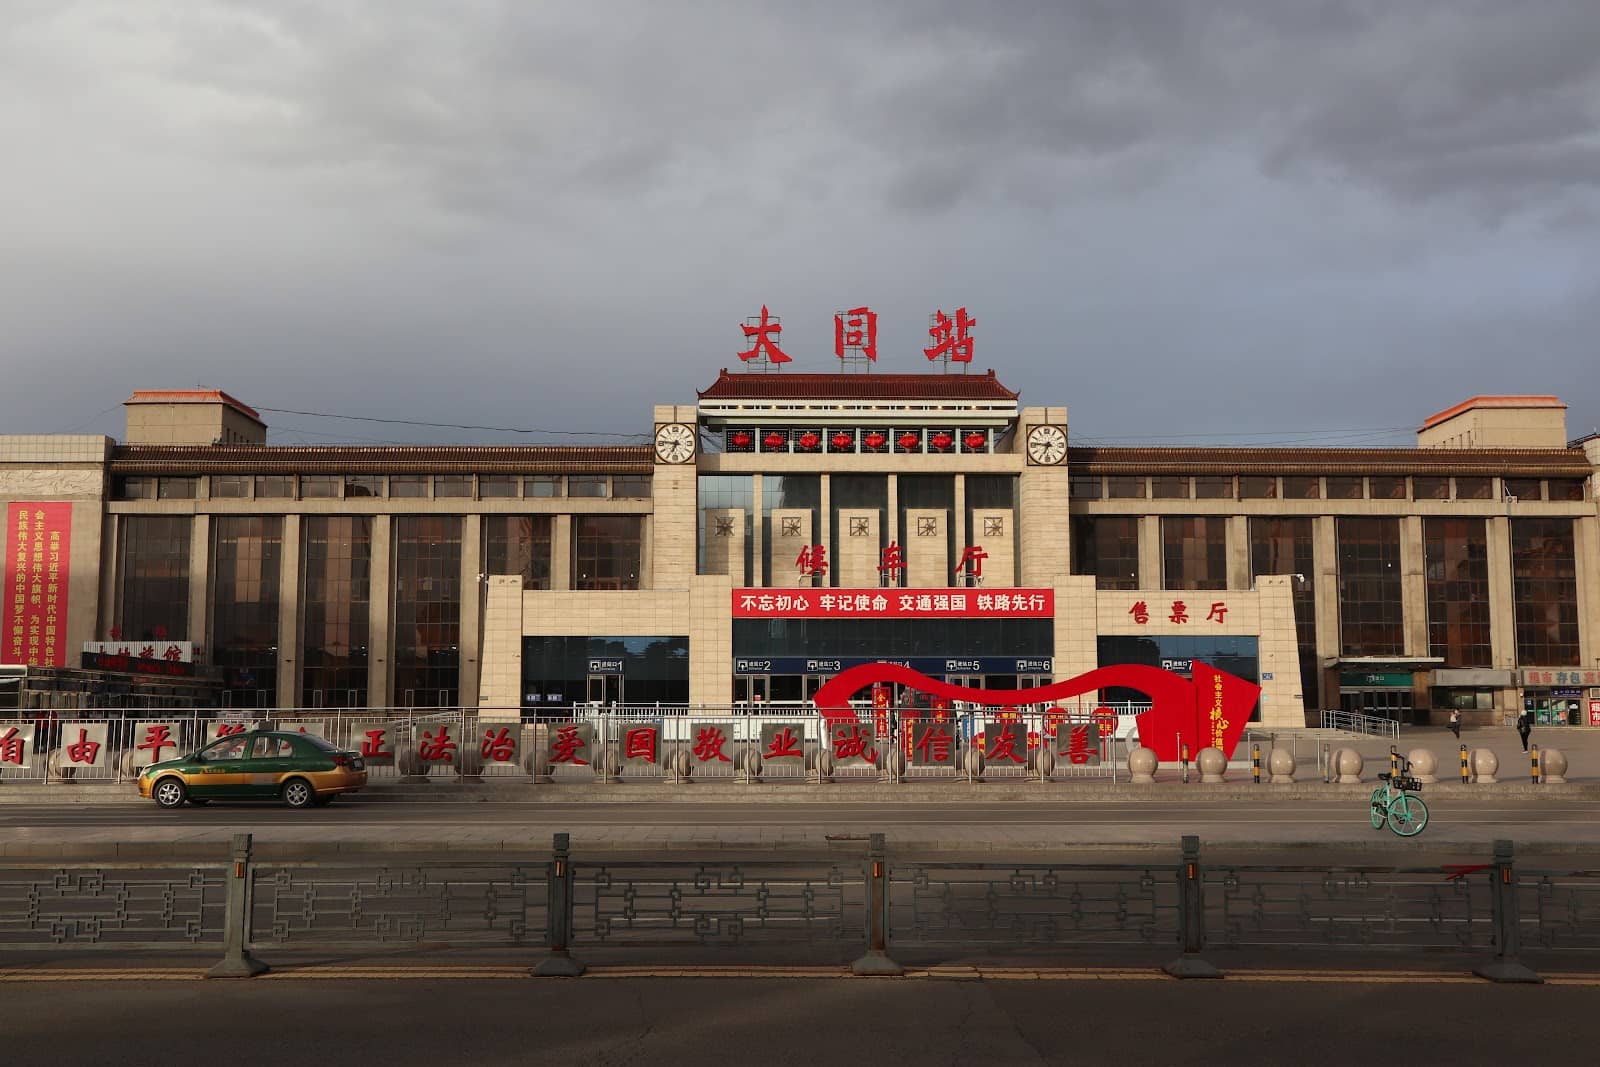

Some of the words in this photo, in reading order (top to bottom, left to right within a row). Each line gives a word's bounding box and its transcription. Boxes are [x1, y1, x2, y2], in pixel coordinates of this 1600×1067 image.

[737, 304, 977, 364] 大同站
[740, 594, 810, 612] 不忘初心
[819, 594, 889, 612] 牢记使命
[898, 594, 967, 612] 交通强国
[976, 594, 1046, 612] 铁路先行
[1129, 600, 1229, 625] 售票厅
